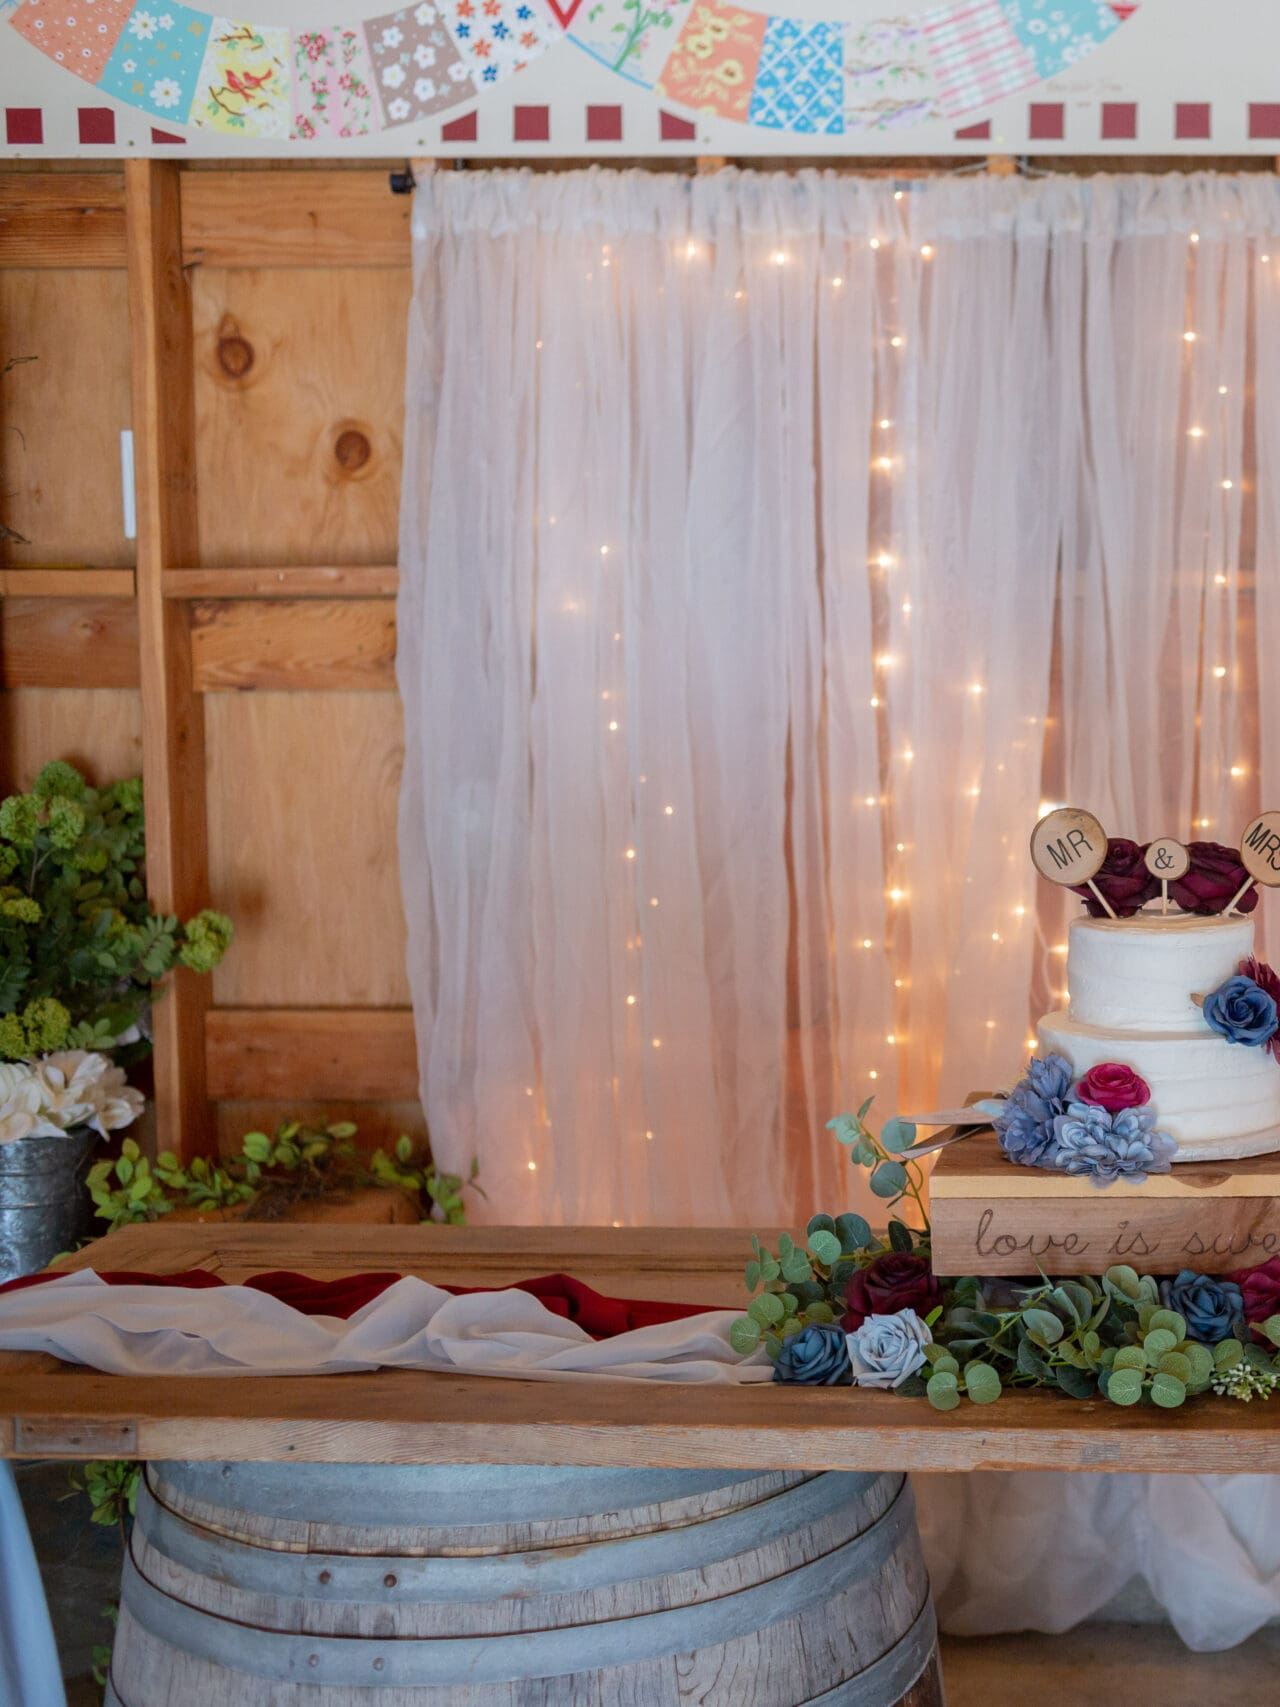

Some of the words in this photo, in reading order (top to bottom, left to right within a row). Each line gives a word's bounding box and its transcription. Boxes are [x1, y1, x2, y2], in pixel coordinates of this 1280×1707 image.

[1046, 828, 1094, 870] MR
[1154, 846, 1175, 870] &
[975, 1208, 1092, 1256] love
[1107, 1220, 1161, 1256] is
